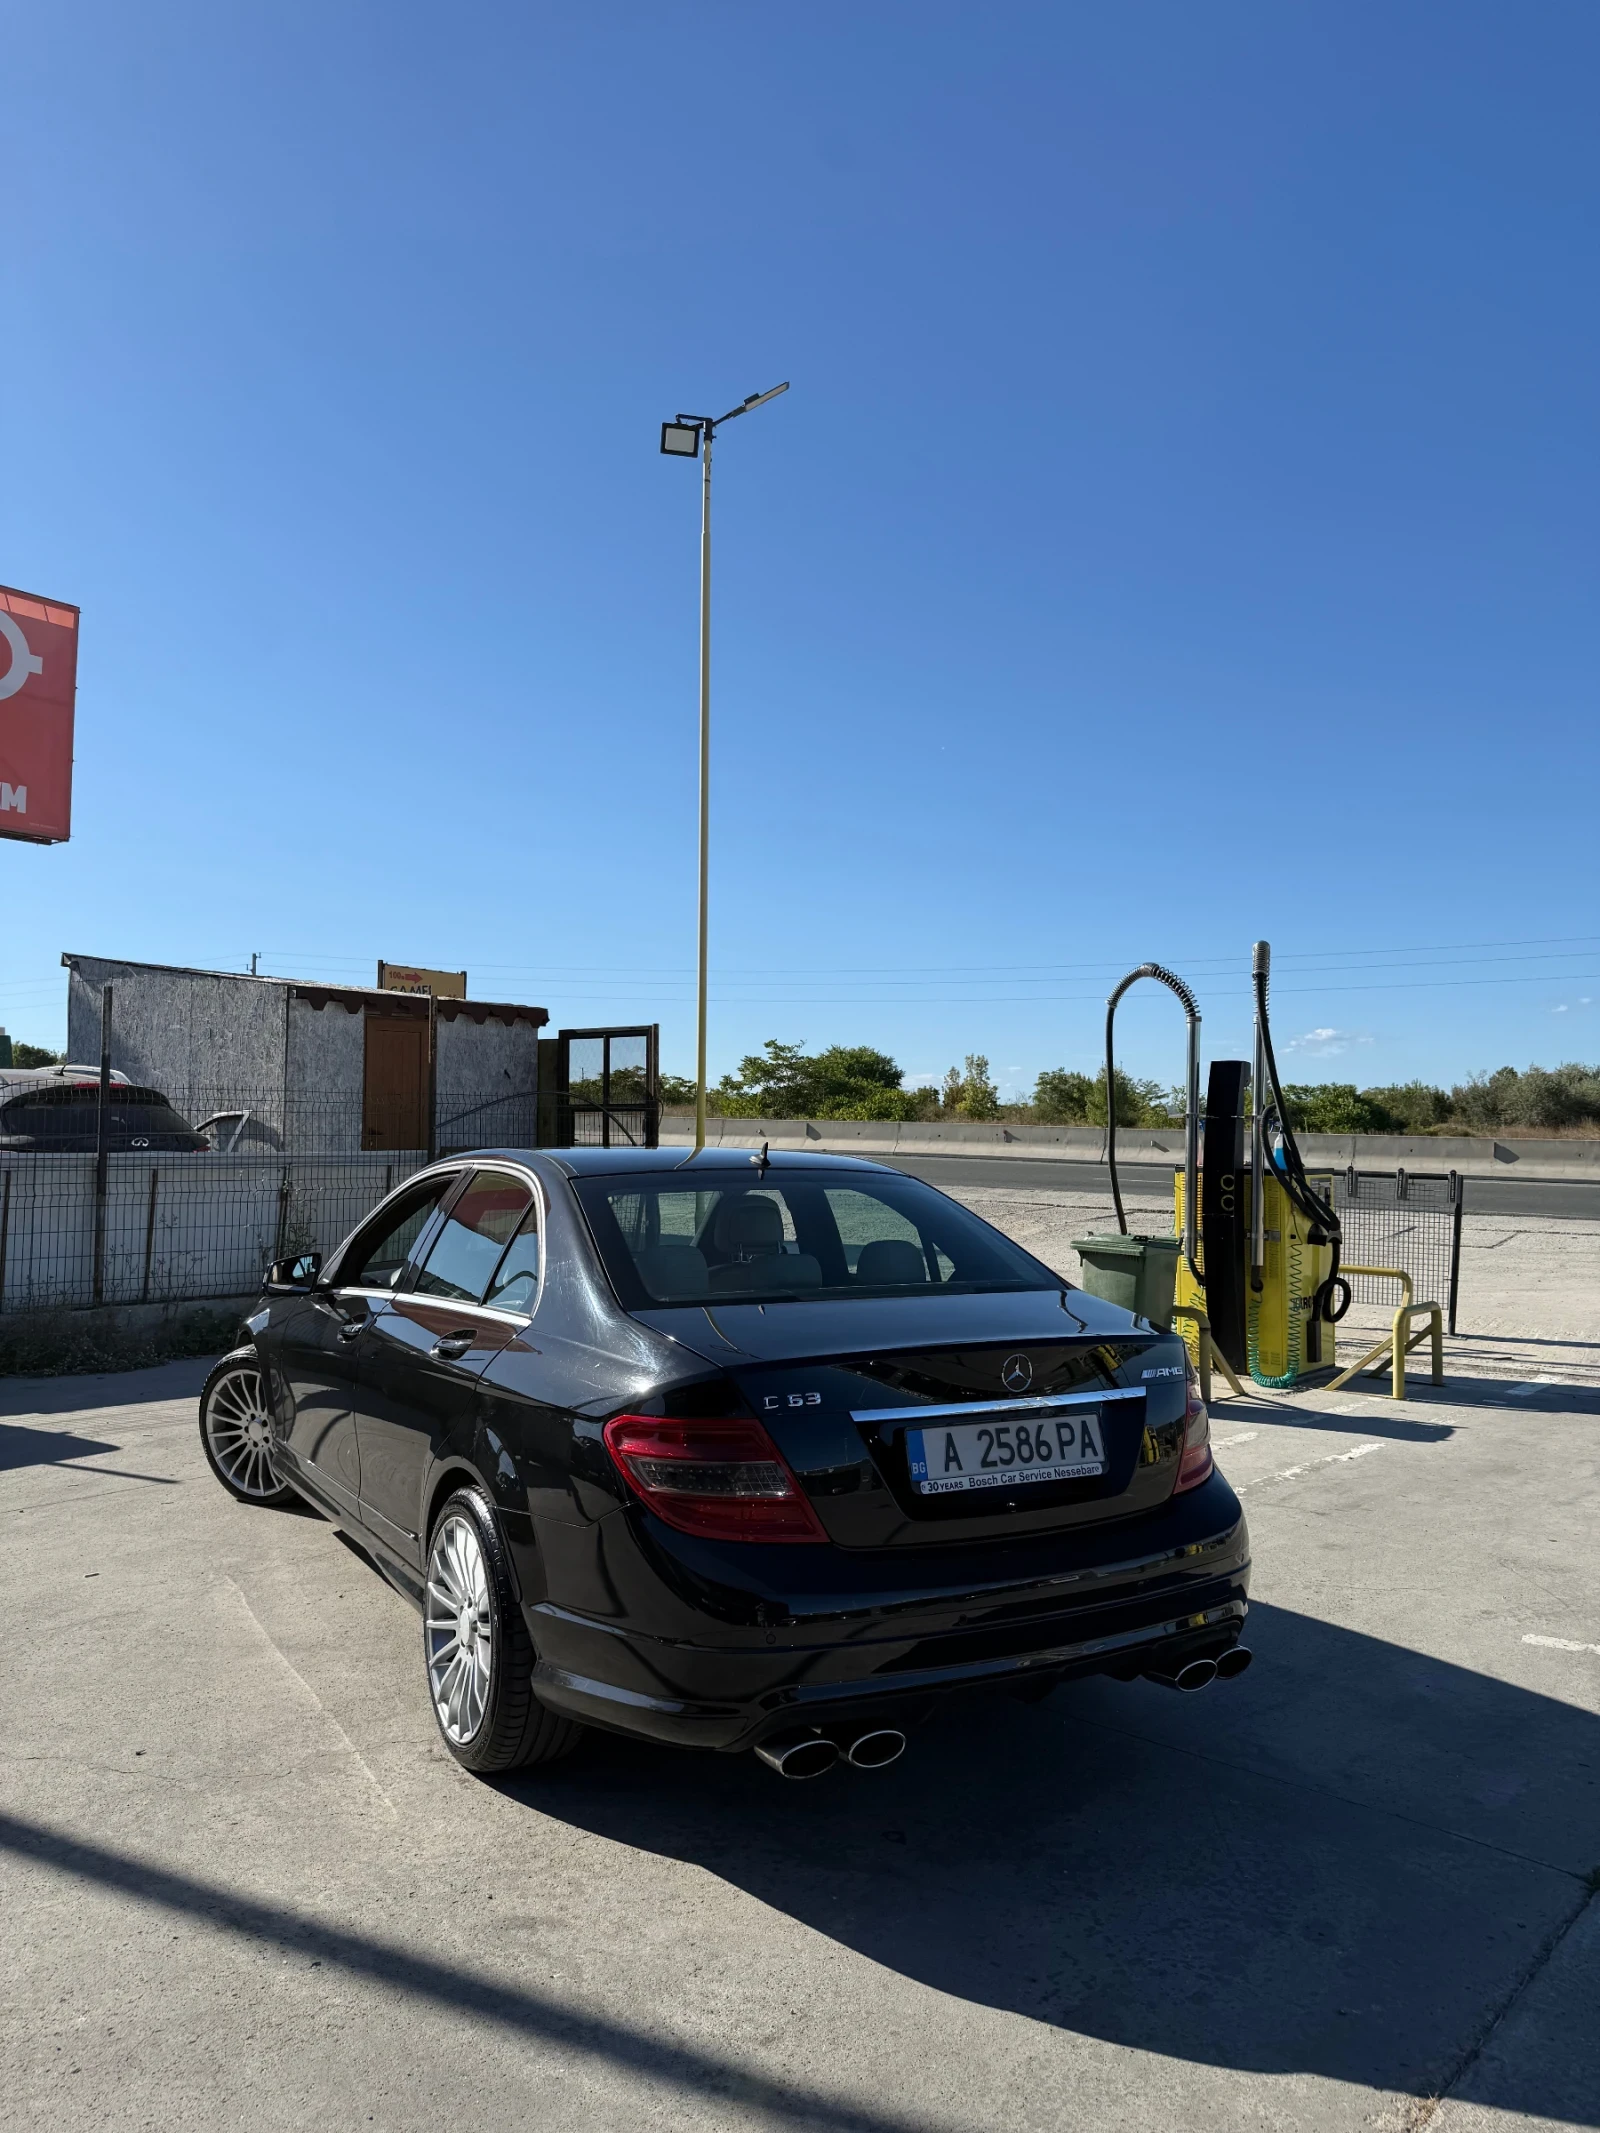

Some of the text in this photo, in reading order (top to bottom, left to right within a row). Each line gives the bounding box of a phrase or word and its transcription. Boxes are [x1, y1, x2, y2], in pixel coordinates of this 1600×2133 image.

[0, 782, 27, 814] M
[1156, 1366, 1183, 1378] AMG
[764, 1392, 821, 1409] C 63
[944, 1420, 1099, 1472] A 2586 PA
[911, 1462, 926, 1474] BG
[968, 1475, 998, 1488] Bosch
[1000, 1473, 1017, 1484] Car
[1018, 1470, 1052, 1482] Service
[1054, 1465, 1096, 1478] Nessebar
